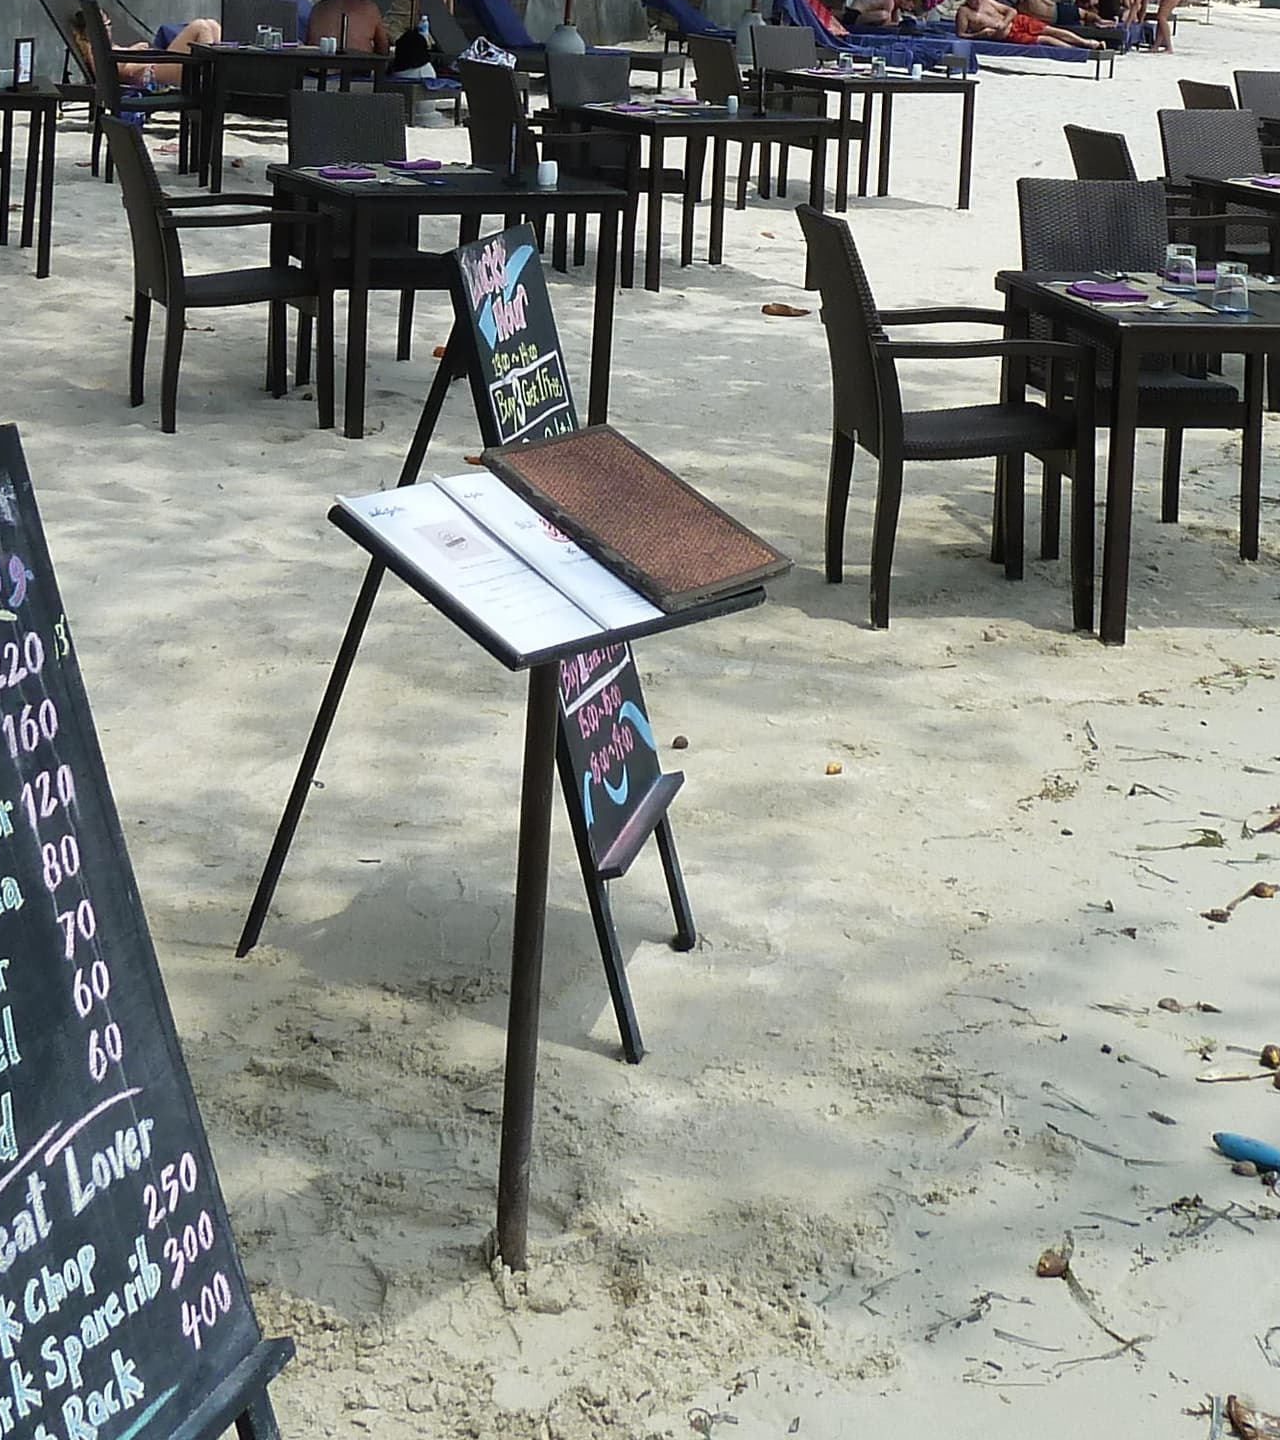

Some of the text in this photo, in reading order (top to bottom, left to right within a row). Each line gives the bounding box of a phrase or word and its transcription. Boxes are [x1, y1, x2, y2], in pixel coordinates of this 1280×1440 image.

[461, 238, 509, 312] Lucky
[491, 283, 529, 342] Hour
[494, 389, 518, 433] Buy
[522, 379, 540, 408] Get
[541, 367, 563, 398] Free
[2, 698, 58, 759] 160
[21, 764, 72, 829] 120
[42, 835, 80, 892] 80
[56, 899, 96, 960] 70
[73, 960, 110, 1018] 60
[88, 1023, 123, 1083] 60
[63, 1117, 154, 1217] Lover
[23, 1243, 97, 1325] Chop
[142, 1151, 198, 1230] 250
[163, 1211, 214, 1290] 300
[61, 1271, 232, 1440] Rack 400
